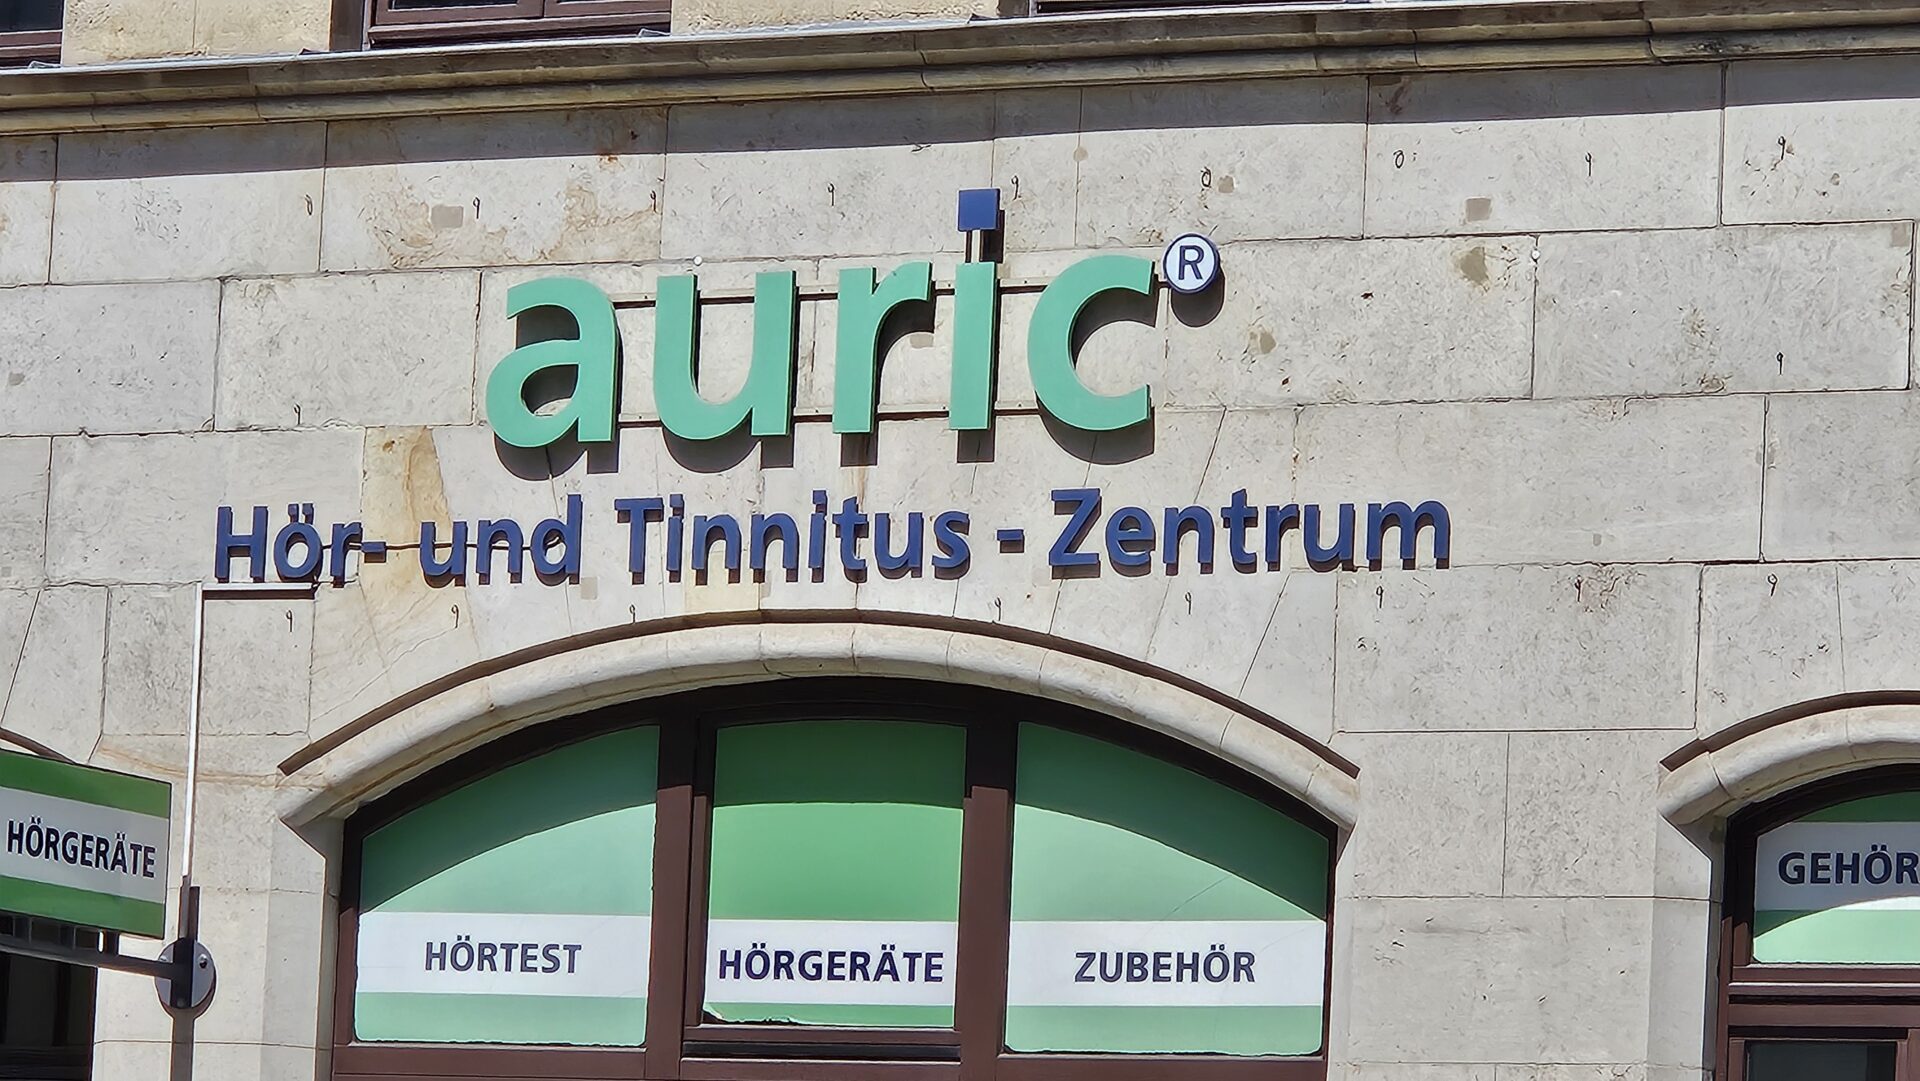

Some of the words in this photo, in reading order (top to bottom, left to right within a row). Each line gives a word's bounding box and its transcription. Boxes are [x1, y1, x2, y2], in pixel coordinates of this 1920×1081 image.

[485, 188, 1156, 448] auric
[419, 494, 583, 581] und
[614, 490, 972, 582] Tinnitus
[1048, 488, 1451, 574] Zentrum
[6, 816, 157, 879] HÖRGERÄTE
[1778, 844, 1920, 885] GEHÖR
[425, 934, 582, 975] HÖRTEST
[718, 942, 944, 983] HÖRGERÄTE
[1074, 943, 1256, 983] ZUBEHÖR
